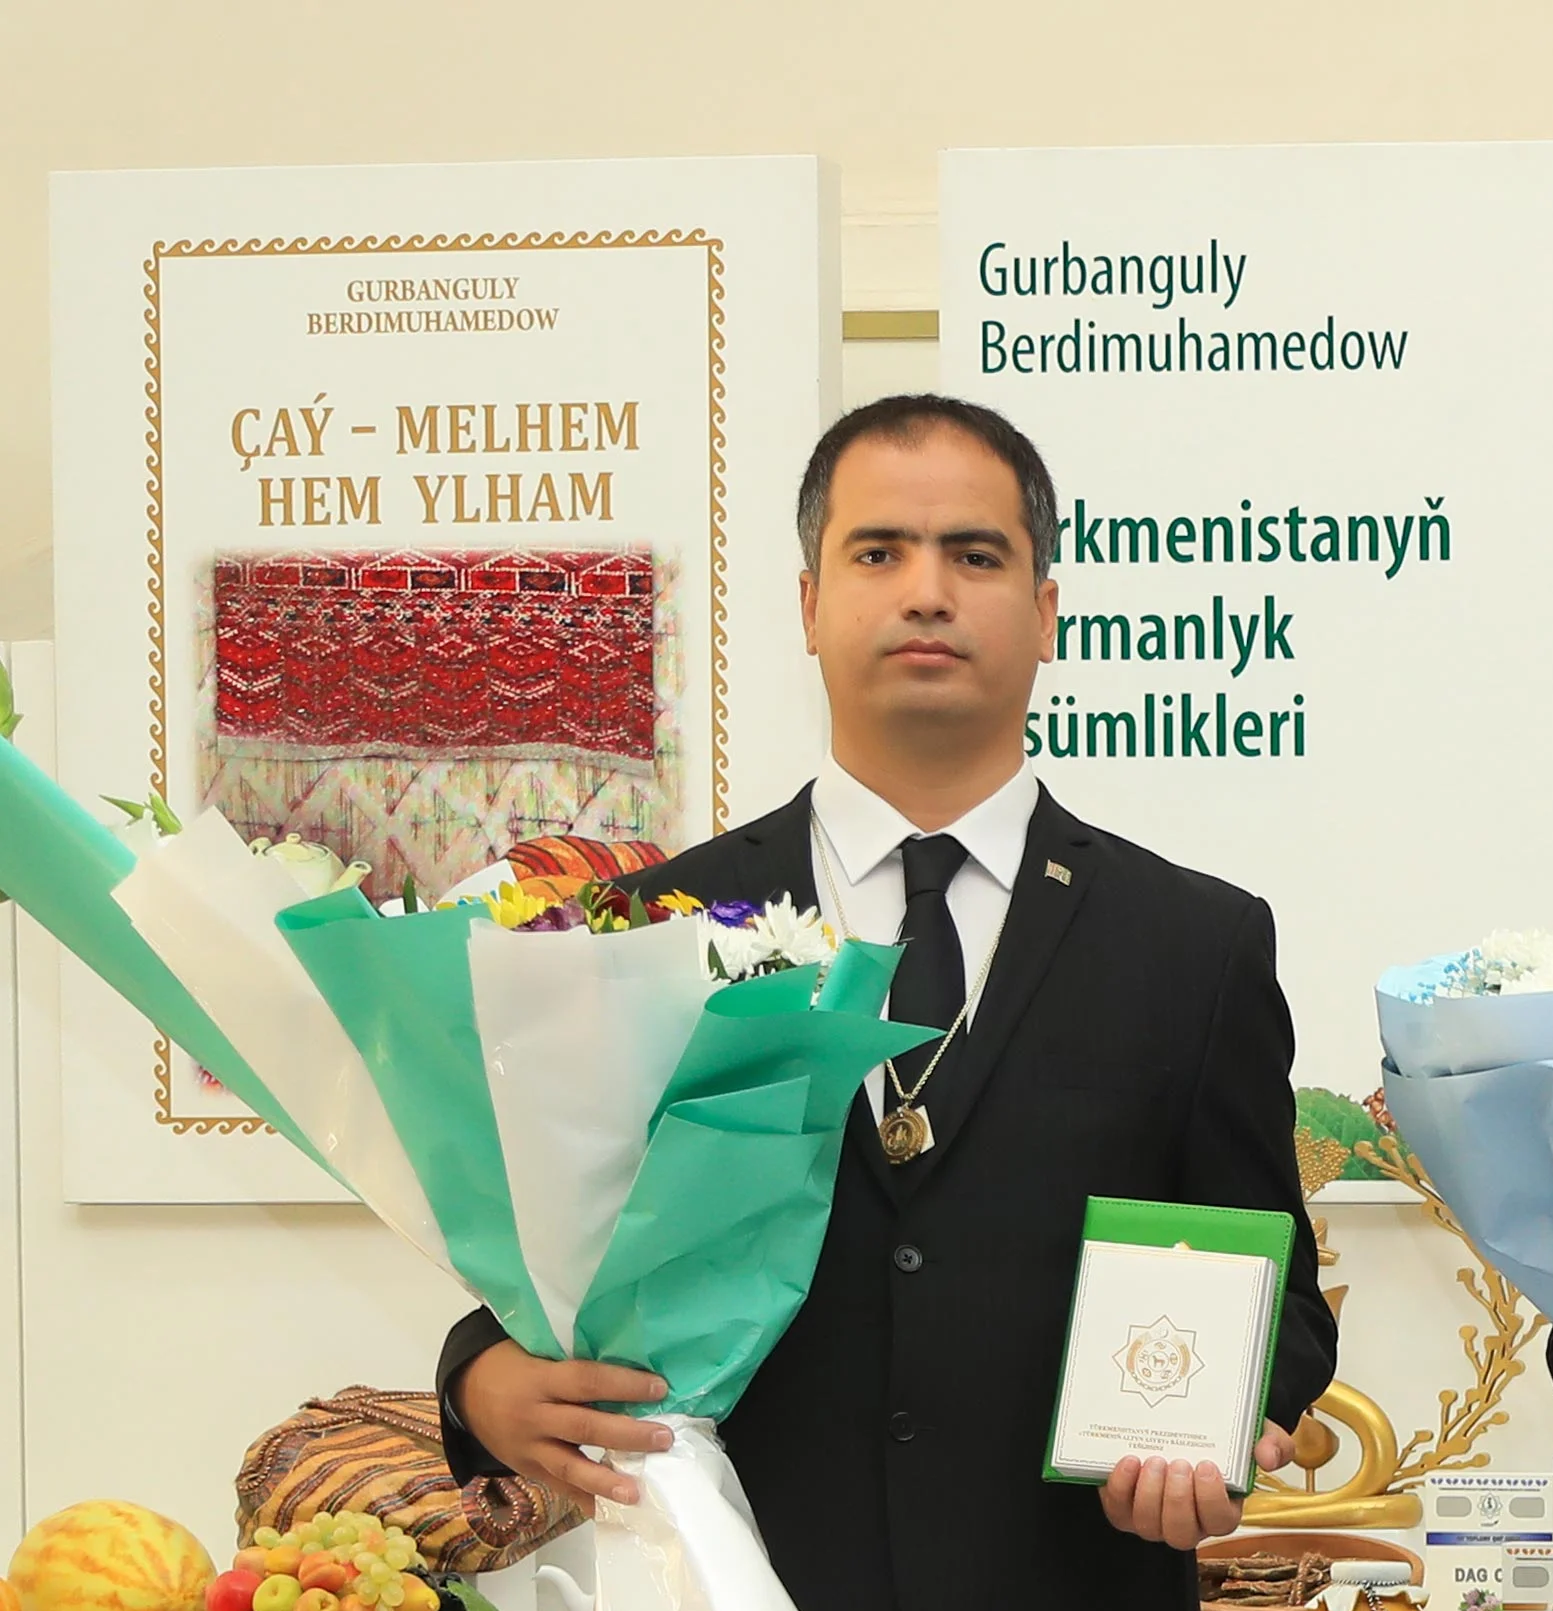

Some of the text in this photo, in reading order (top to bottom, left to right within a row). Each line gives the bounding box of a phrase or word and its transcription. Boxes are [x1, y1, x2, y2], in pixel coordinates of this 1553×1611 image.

[347, 276, 520, 303] GURBANGULY
[979, 238, 1247, 310] Gurbanguly
[306, 307, 560, 335] BERDIMUHAMEDOW
[981, 315, 1409, 374] Berdimuhamedow
[231, 393, 334, 472] ÇAÝ
[396, 401, 640, 454] MELHEM
[258, 471, 615, 527] HEM YLHAM
[1052, 496, 1451, 581] rkmenistanyň
[1057, 595, 1295, 679] rmanlyk
[1024, 692, 1305, 758] sümlikleri
[1455, 1567, 1489, 1583] DAG
